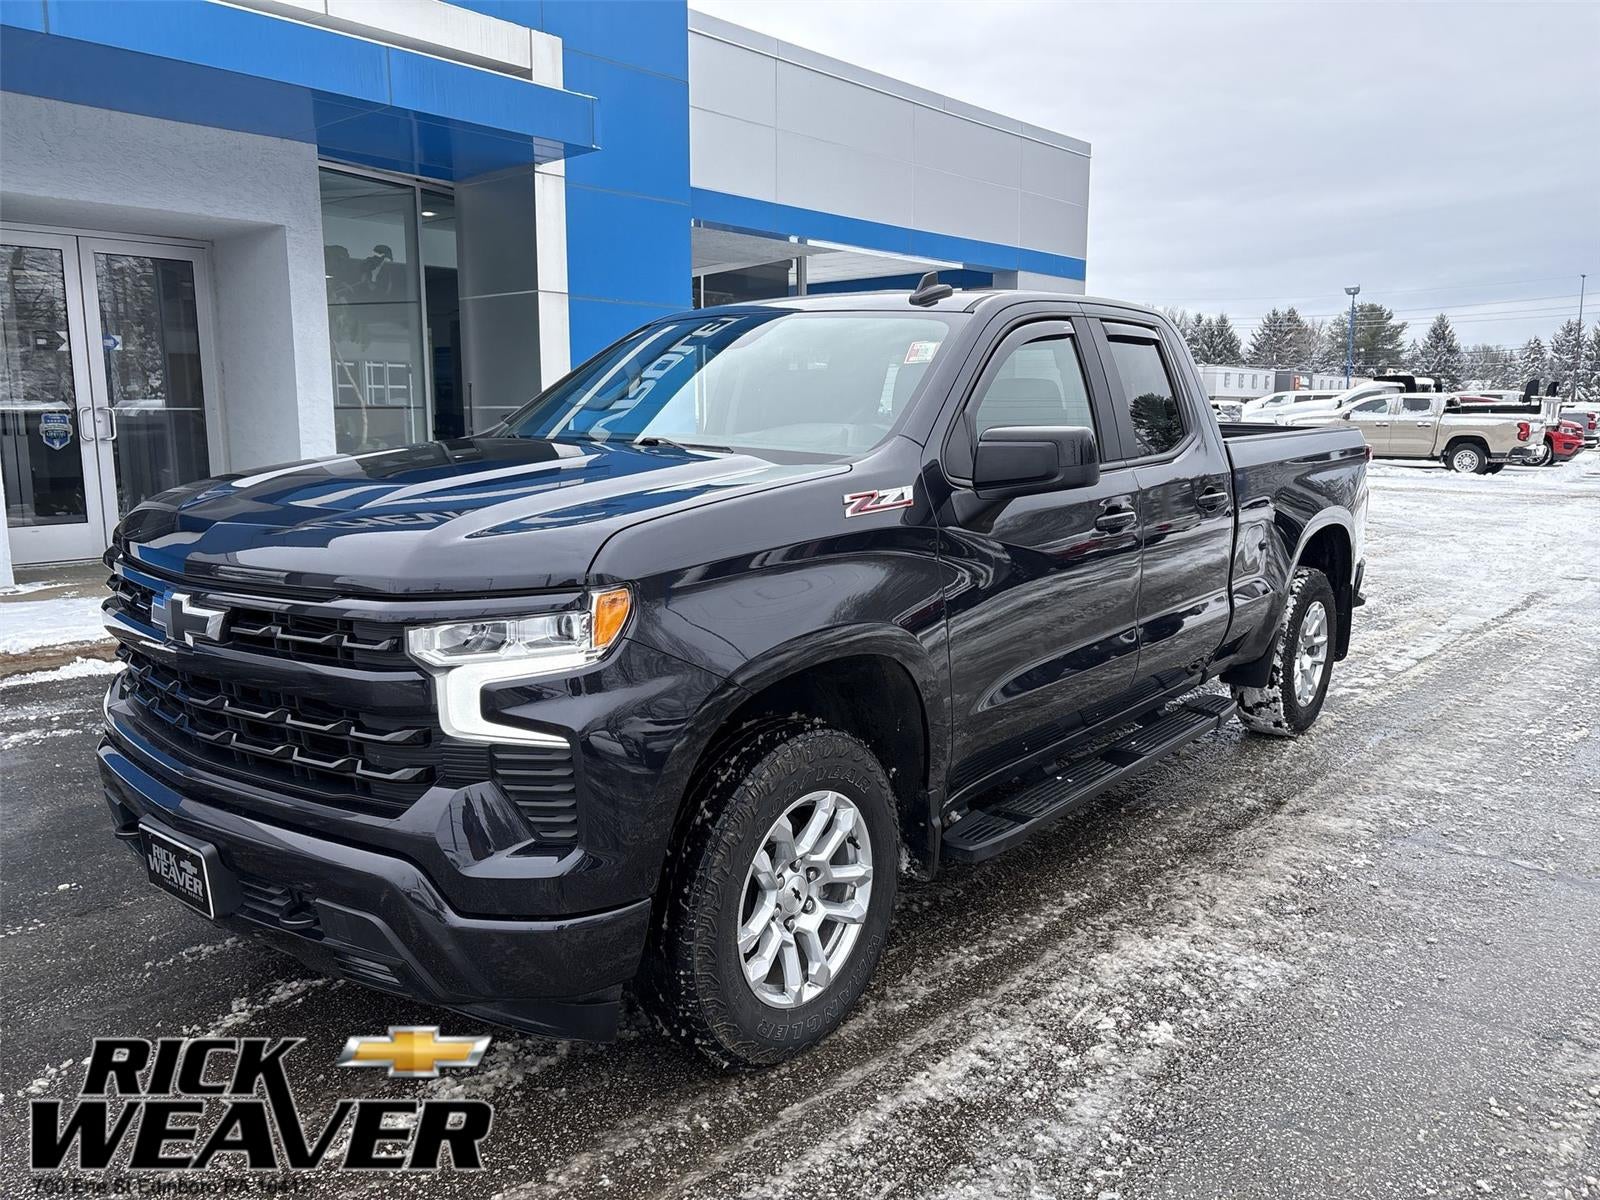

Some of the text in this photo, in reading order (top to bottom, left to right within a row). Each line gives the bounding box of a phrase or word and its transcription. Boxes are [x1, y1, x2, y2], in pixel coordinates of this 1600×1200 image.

[843, 485, 915, 518] Z71
[743, 766, 873, 866] GOODYEAR
[148, 854, 204, 898] WEAVER
[152, 843, 177, 866] RICK
[757, 935, 882, 1041] WRANGLER
